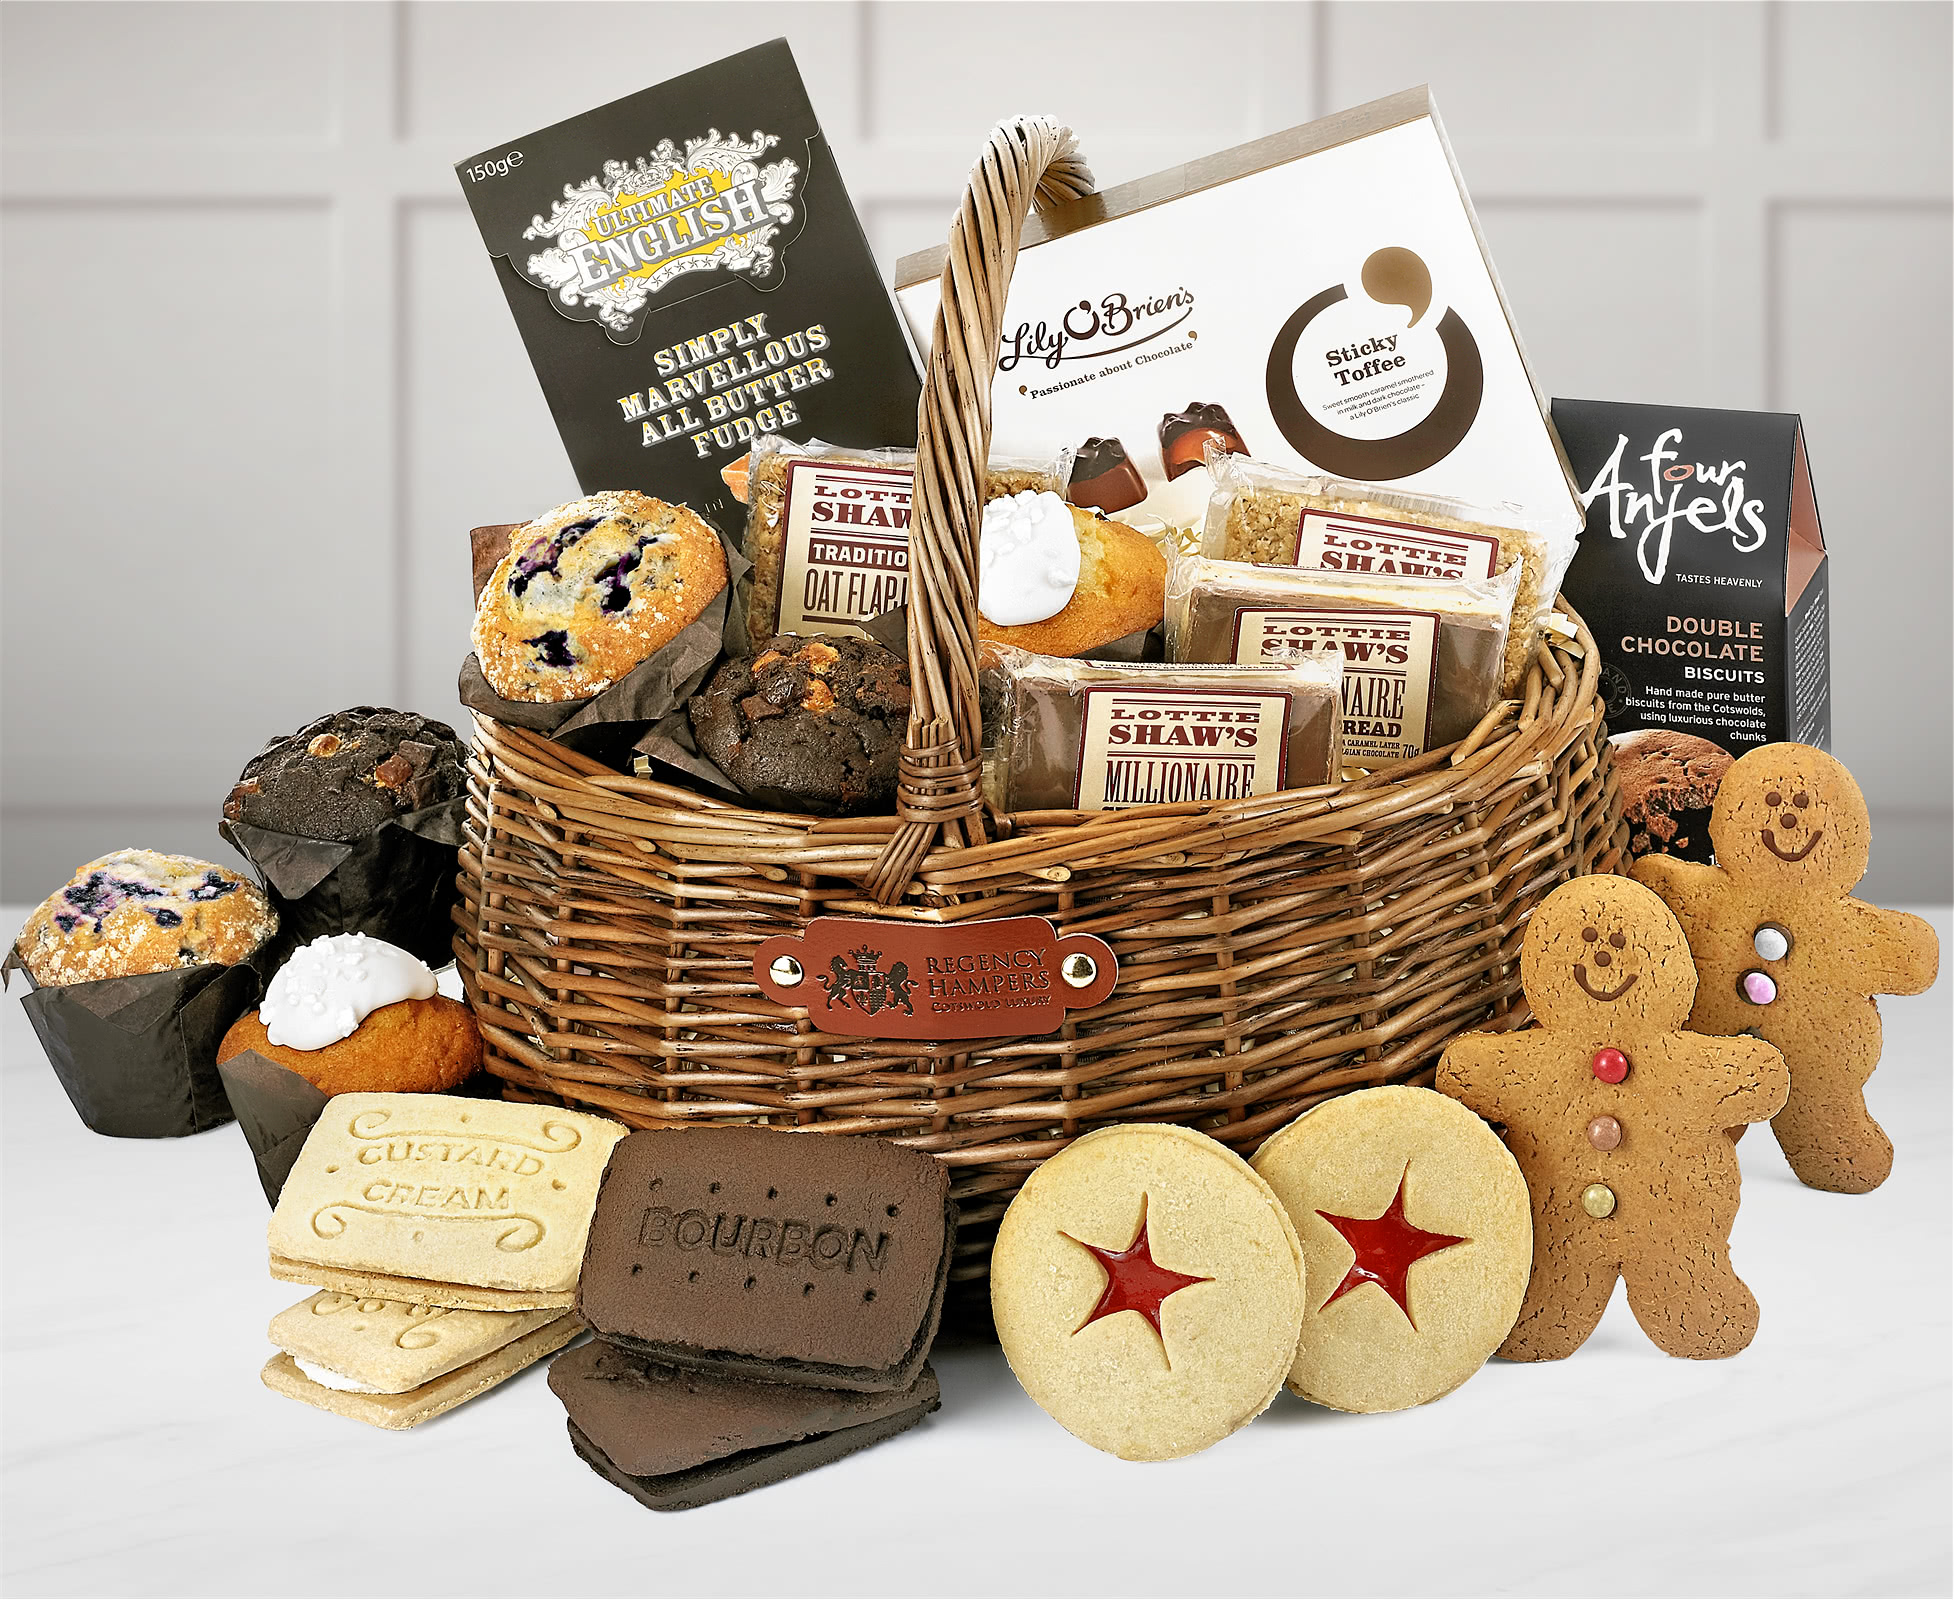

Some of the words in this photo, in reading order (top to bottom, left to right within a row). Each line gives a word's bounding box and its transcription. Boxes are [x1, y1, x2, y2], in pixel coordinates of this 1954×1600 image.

[591, 176, 715, 237] ULTIMATE
[568, 179, 772, 292] ENGLISH
[999, 321, 1069, 371] Lily
[1063, 286, 1194, 340] O'Brien's
[654, 312, 769, 377] SIMPLY
[1325, 334, 1398, 368] Sticky
[617, 324, 831, 422] MARVELLOUS
[1099, 360, 1133, 378] about
[1334, 355, 1406, 387] Toffee
[641, 406, 704, 447] ALL
[703, 357, 834, 423] BUTTER
[1322, 400, 1343, 411] Sweet
[1344, 391, 1370, 404] smooth
[1370, 381, 1397, 395] caramel
[1397, 369, 1434, 386] smothered
[1344, 403, 1359, 413] milk
[1358, 399, 1372, 409] and
[1372, 394, 1387, 404] dark
[1387, 384, 1421, 399] chocolate
[1355, 410, 1366, 419] Lily
[1366, 400, 1397, 415] O'Brien's
[1396, 393, 1420, 405] classic
[690, 400, 801, 459] FUDGE
[1639, 428, 1747, 505] four
[814, 485, 912, 504] LOTT
[811, 501, 911, 529] SHAW
[813, 543, 908, 567] TRADITIO
[1323, 534, 1467, 566] LOTTIE
[804, 568, 844, 613] OAT
[847, 572, 908, 615] FLAPJ
[1676, 573, 1711, 585] TASTES
[1712, 576, 1763, 589] HEAVENLY
[1263, 625, 1411, 641] LOTTIE
[1666, 615, 1764, 640] DOUBLE
[1621, 636, 1764, 663] CHOCOLATE
[1684, 666, 1765, 684] BISCUITS
[1625, 697, 1665, 709] biscuits
[1668, 700, 1692, 712] from
[1693, 701, 1711, 713] the
[1712, 703, 1766, 718] Cotswolds,
[1645, 685, 1673, 697] Hand
[1675, 687, 1704, 699] made
[1706, 691, 1731, 703] pure
[1733, 691, 1766, 704] butter
[1110, 708, 1260, 724] LOTTIE
[1342, 720, 1402, 738] READ
[1640, 711, 1667, 724] using
[1668, 713, 1714, 726] luxurious
[1715, 715, 1767, 729] chocolate
[1107, 724, 1258, 748] SHAW'S
[1347, 739, 1378, 748] CARAMEL
[1379, 741, 1400, 750] LAYER
[1730, 731, 1767, 742] chunks
[1362, 749, 1400, 759] CHOCOLATE
[1103, 760, 1255, 804] MILLIONAIRE
[926, 948, 1047, 976] REGENCY
[928, 970, 1051, 998] HAMPERS
[931, 1000, 1001, 1013] COTSWOLD
[1006, 995, 1052, 1008] LUXURY
[356, 1141, 545, 1177] CUSTARD
[362, 1178, 510, 1209] CREAM
[638, 1206, 892, 1274] BOURBON
